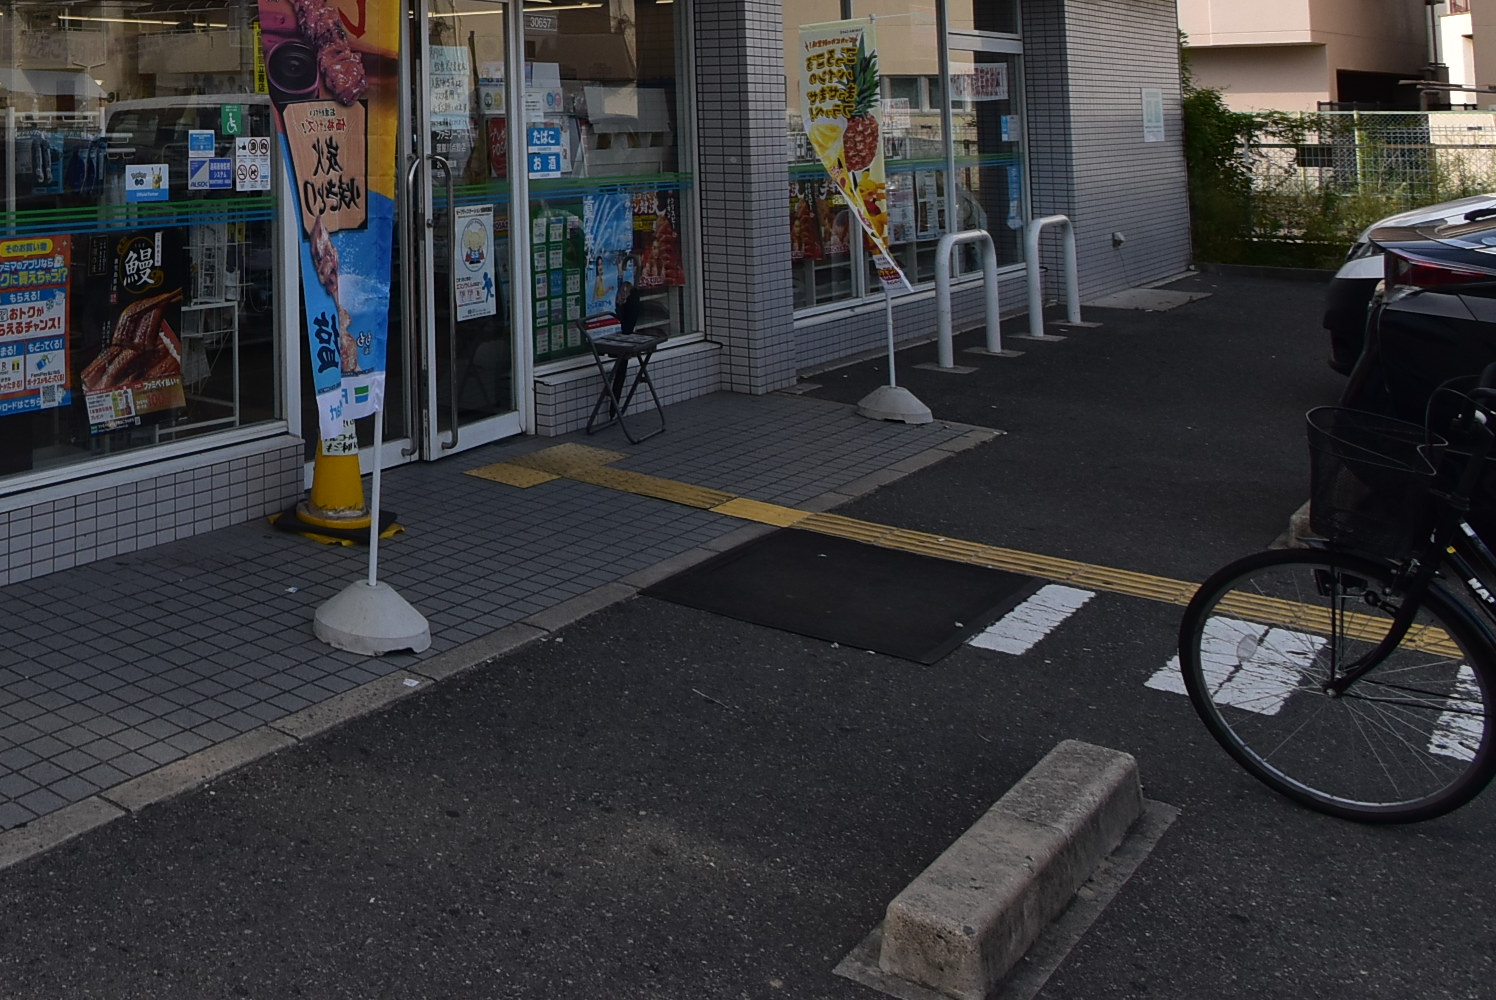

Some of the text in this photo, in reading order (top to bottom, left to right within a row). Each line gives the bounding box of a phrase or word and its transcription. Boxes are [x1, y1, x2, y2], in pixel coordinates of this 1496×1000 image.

[530, 17, 551, 28] 30657
[532, 129, 556, 144] たばこ
[533, 155, 557, 170] お酒
[123, 247, 155, 287] 鰻
[9, 290, 41, 303] もらえる!
[9, 306, 44, 320] おトクが
[27, 337, 63, 352] もどってくる!
